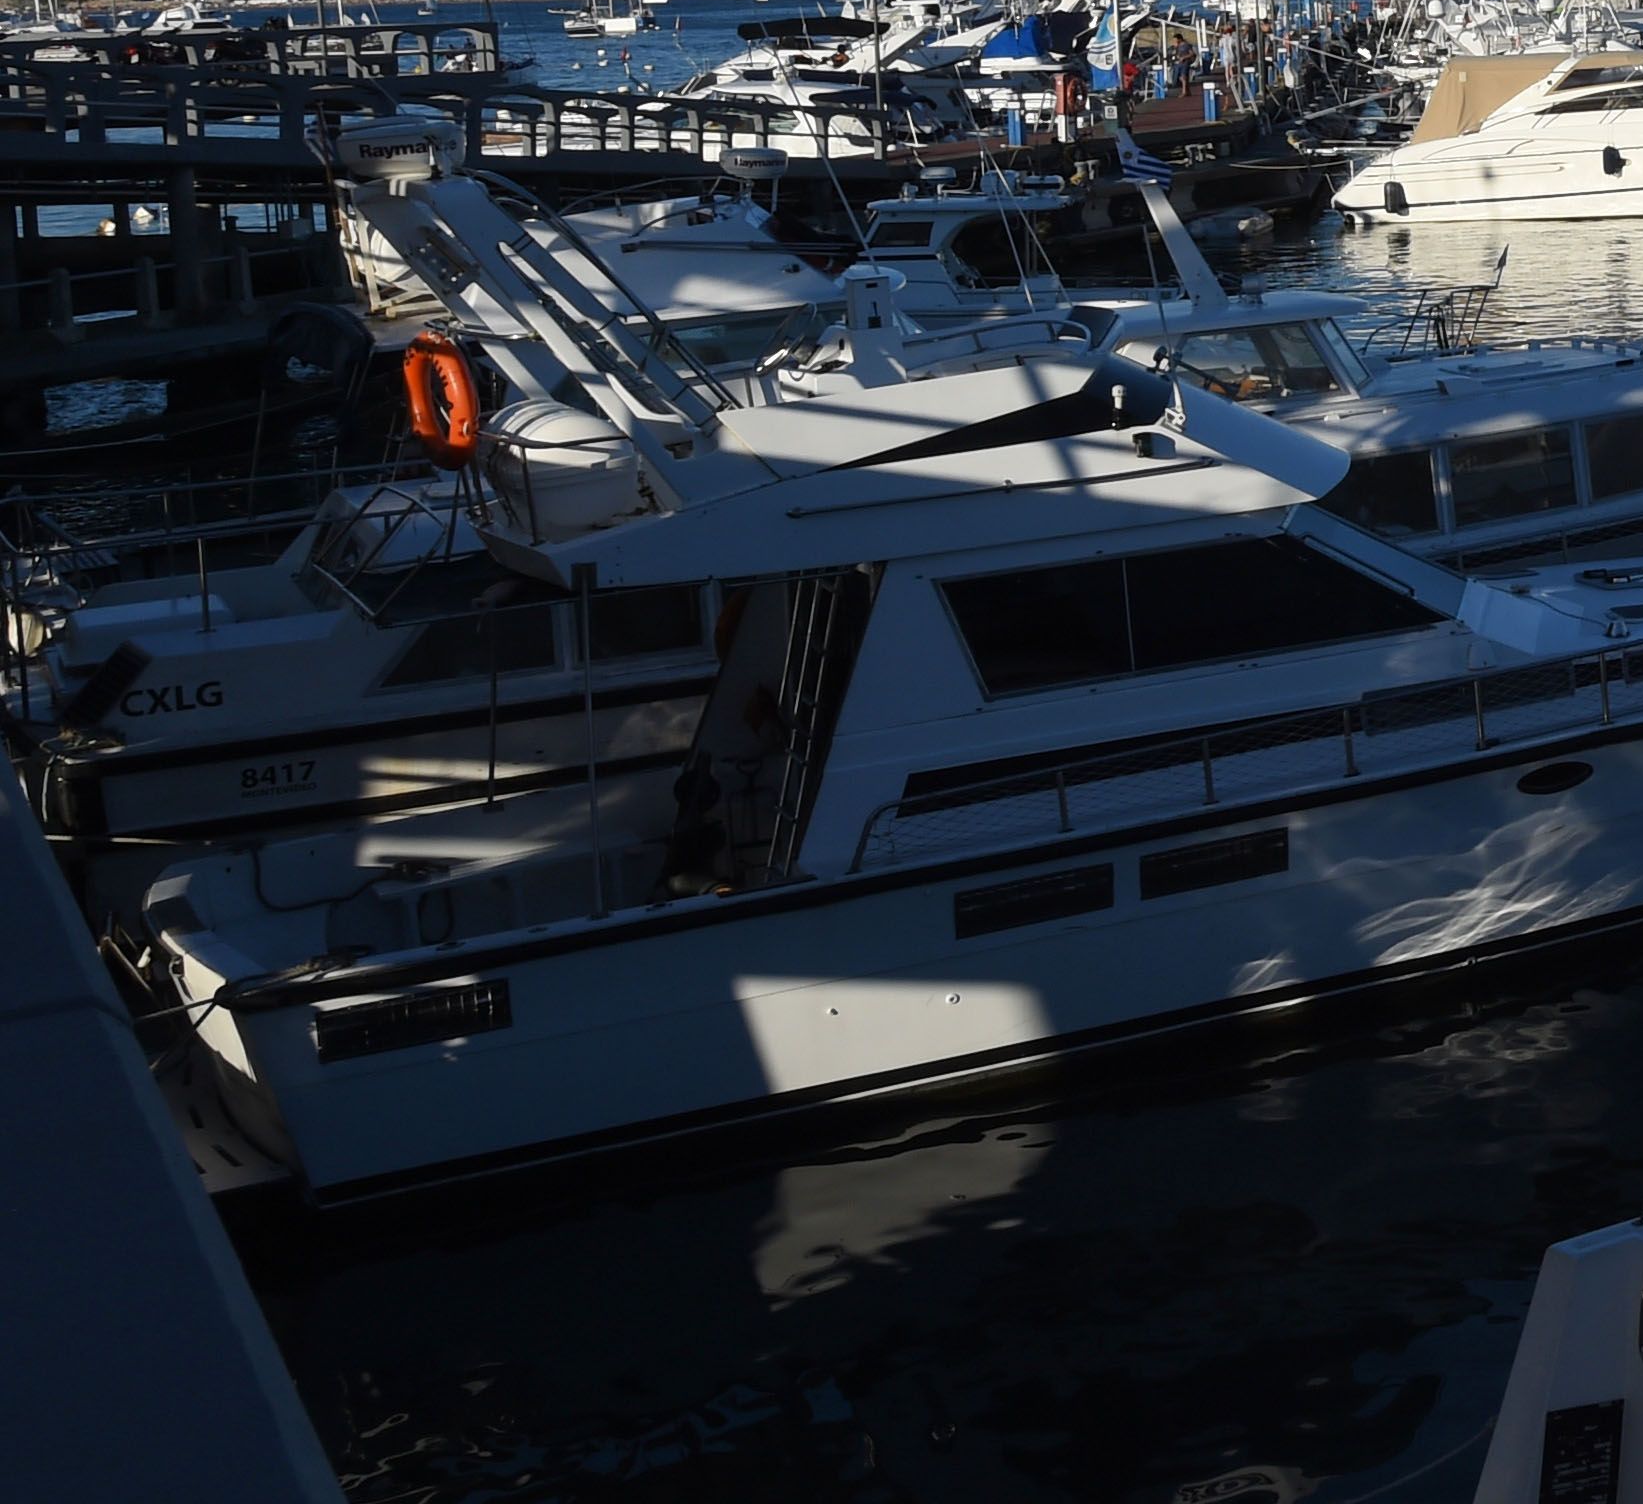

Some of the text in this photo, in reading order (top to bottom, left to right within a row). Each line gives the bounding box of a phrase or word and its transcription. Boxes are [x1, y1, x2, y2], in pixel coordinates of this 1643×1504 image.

[120, 682, 223, 717] CXLG
[241, 761, 316, 788] 8417
[241, 782, 317, 799] MONTEVIDEO
